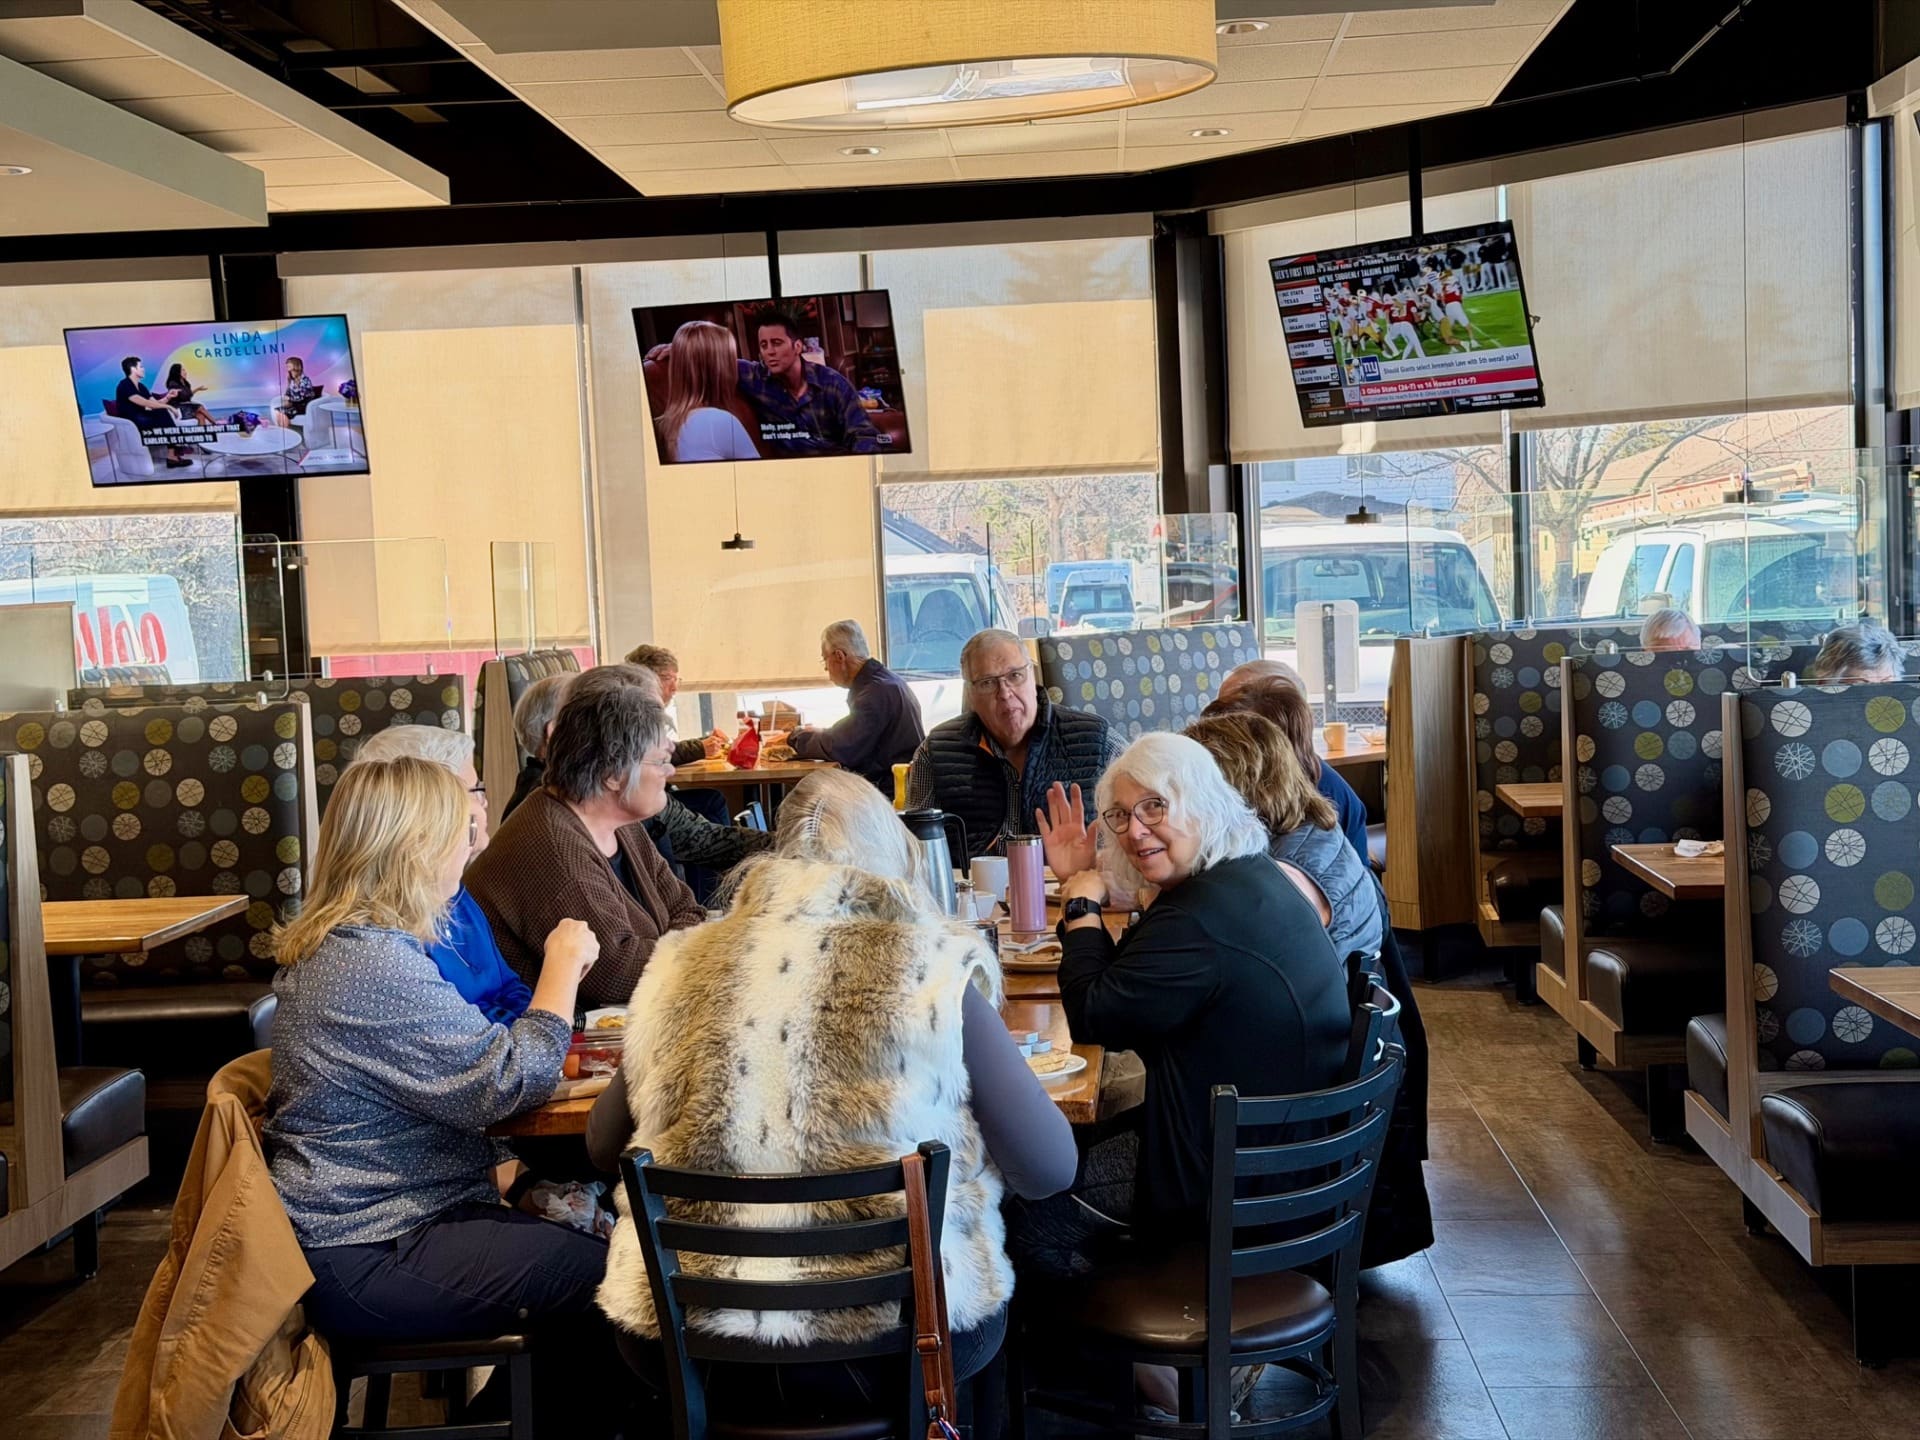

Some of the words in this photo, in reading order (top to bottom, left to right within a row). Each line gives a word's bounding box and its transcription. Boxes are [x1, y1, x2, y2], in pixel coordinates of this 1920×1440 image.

[1334, 270, 1360, 281] SUDDENLY
[1361, 267, 1382, 277] TALKING
[1383, 264, 1400, 274] ABOUT
[212, 331, 263, 345] LINDA
[194, 343, 285, 358] CARDELLINI
[1488, 355, 1504, 363] overall
[1506, 353, 1519, 362] pick?
[1381, 385, 1397, 393] State
[153, 427, 164, 436] WE
[164, 427, 181, 435] WERE
[181, 426, 205, 434] TALKING
[206, 425, 226, 433] ABOUT
[226, 424, 240, 432] THAT
[777, 423, 795, 431] people
[170, 436, 178, 444] IS
[185, 435, 205, 443] WEIRD
[205, 434, 213, 442] TO
[762, 432, 777, 440] don't
[777, 431, 792, 441] study
